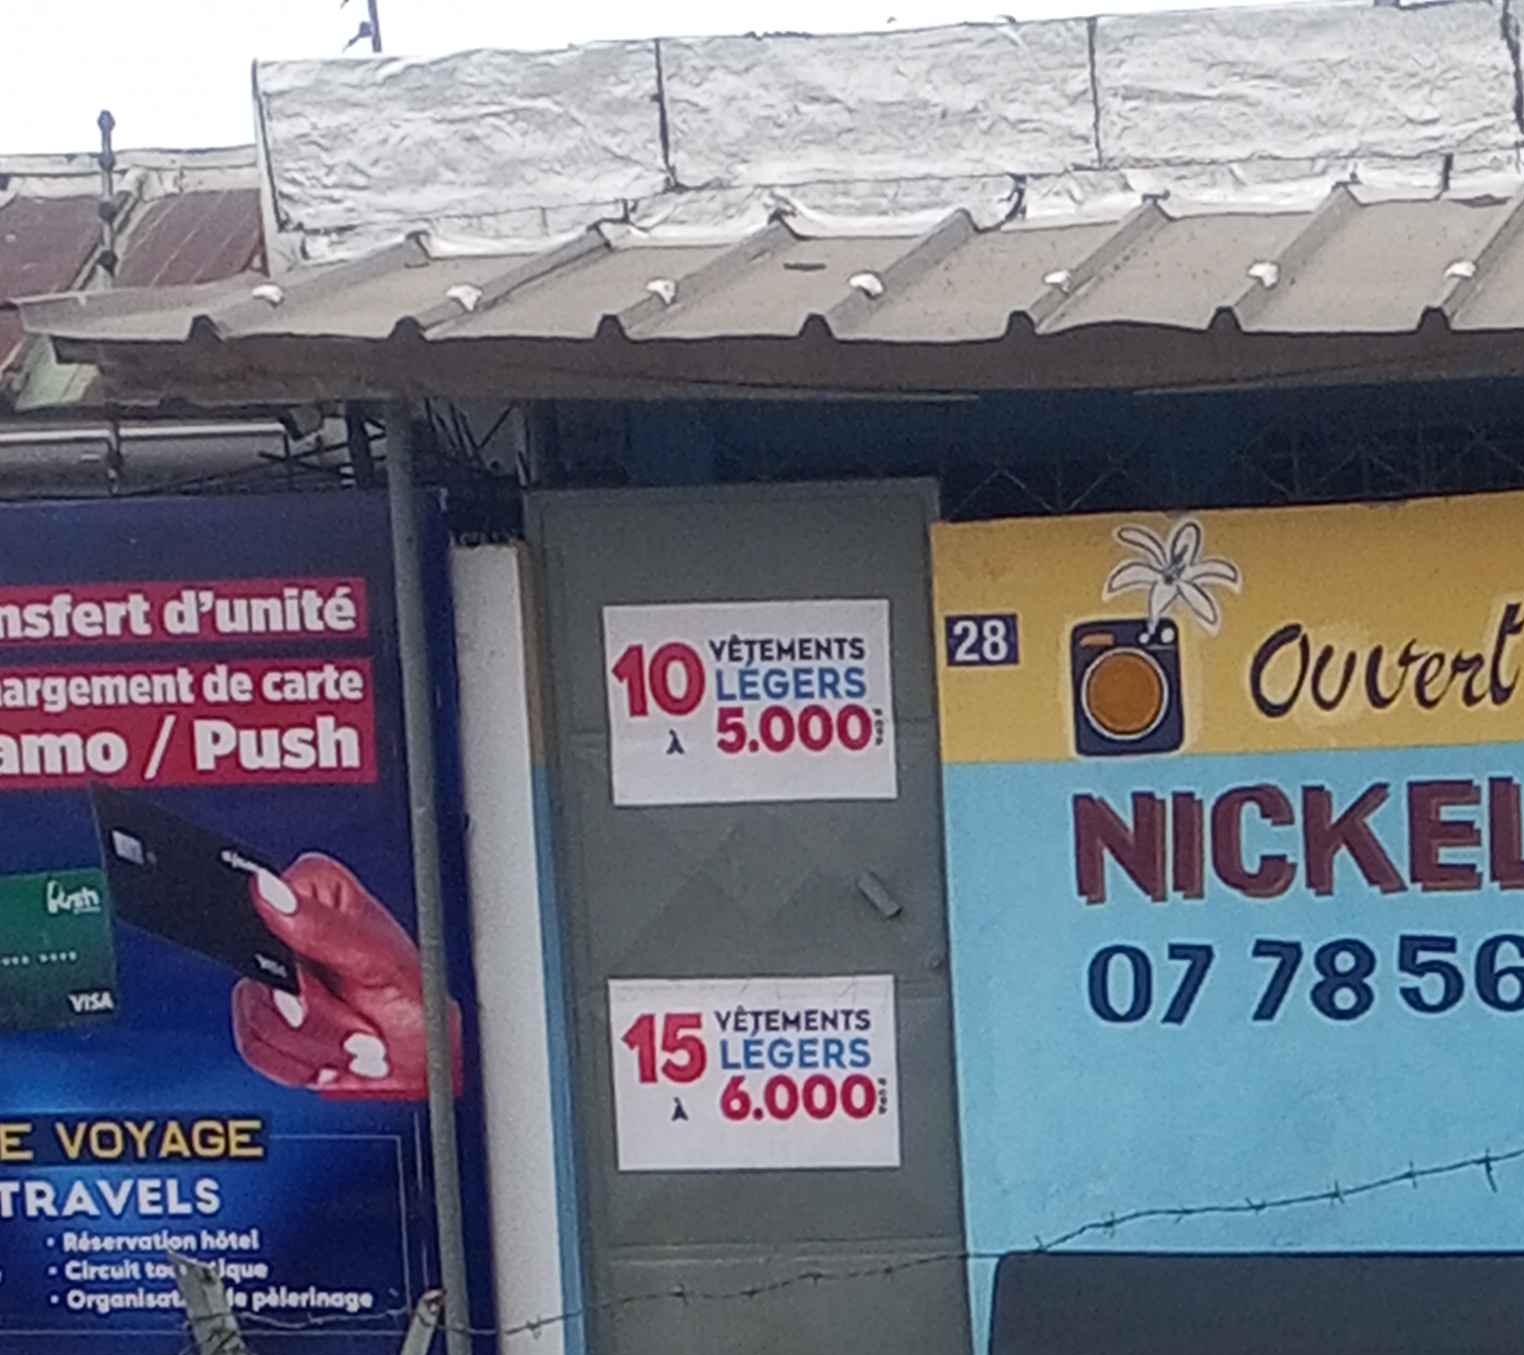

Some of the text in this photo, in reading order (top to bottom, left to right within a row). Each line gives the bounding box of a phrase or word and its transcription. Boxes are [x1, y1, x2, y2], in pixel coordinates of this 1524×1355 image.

[0, 592, 153, 638] nsfert
[709, 634, 865, 662] VÊTEMENTS
[954, 619, 1008, 662] 28
[2, 664, 364, 713] argement de carte
[611, 642, 705, 717] 10
[0, 715, 361, 780] amo / Push
[717, 704, 873, 754] 5.000
[68, 991, 114, 1013] VISA
[1086, 943, 1214, 1025] 07
[1249, 938, 1377, 1021] 78
[715, 1006, 871, 1032] VÊTEMENTS
[621, 1012, 708, 1084] 15
[721, 1074, 876, 1121] 6.000
[0, 1119, 264, 1161] E VOYAGE
[0, 1178, 220, 1217] TRAVELS
[63, 1228, 260, 1252] Réservation hôtel
[65, 1259, 141, 1281] Circuit
[252, 1285, 373, 1313] pèlerinage
